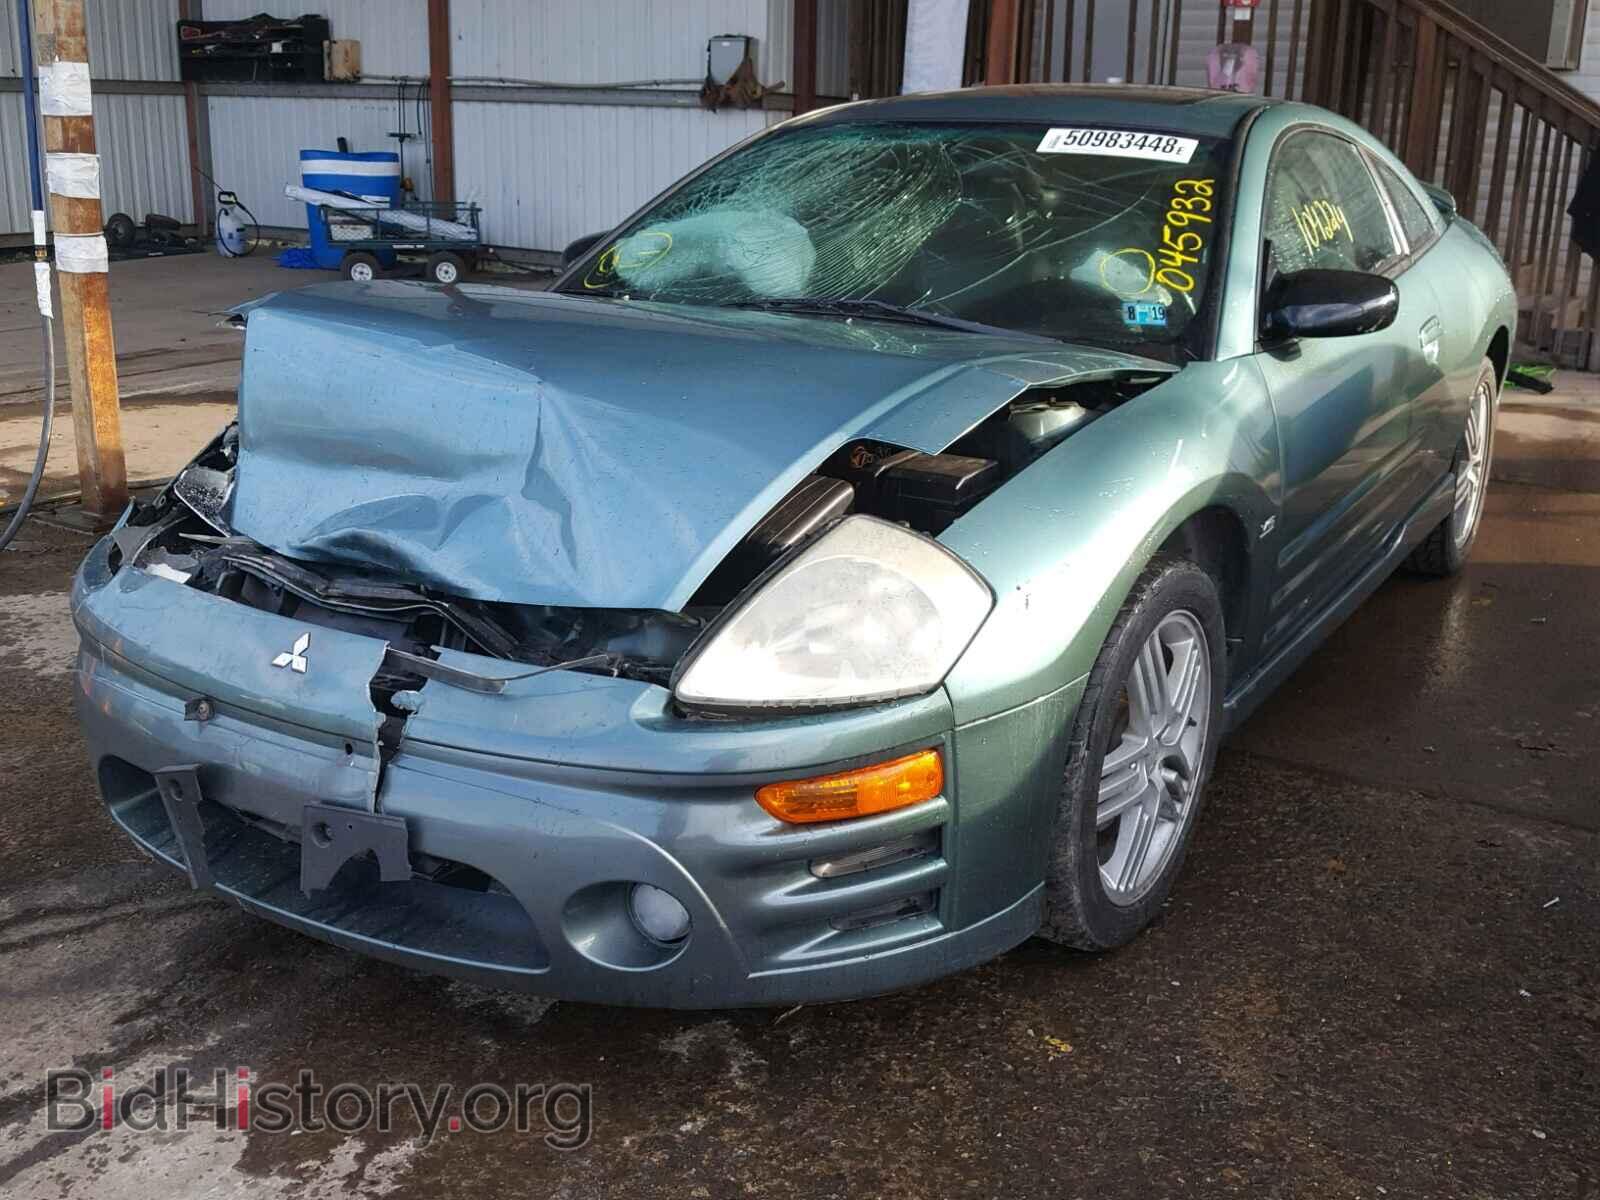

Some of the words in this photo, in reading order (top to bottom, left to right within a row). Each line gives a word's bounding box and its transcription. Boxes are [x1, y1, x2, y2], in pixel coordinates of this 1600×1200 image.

[1063, 130, 1178, 154] 50983448
[1156, 179, 1216, 292] 045932
[1127, 305, 1136, 321] 8
[1151, 306, 1166, 321] 19
